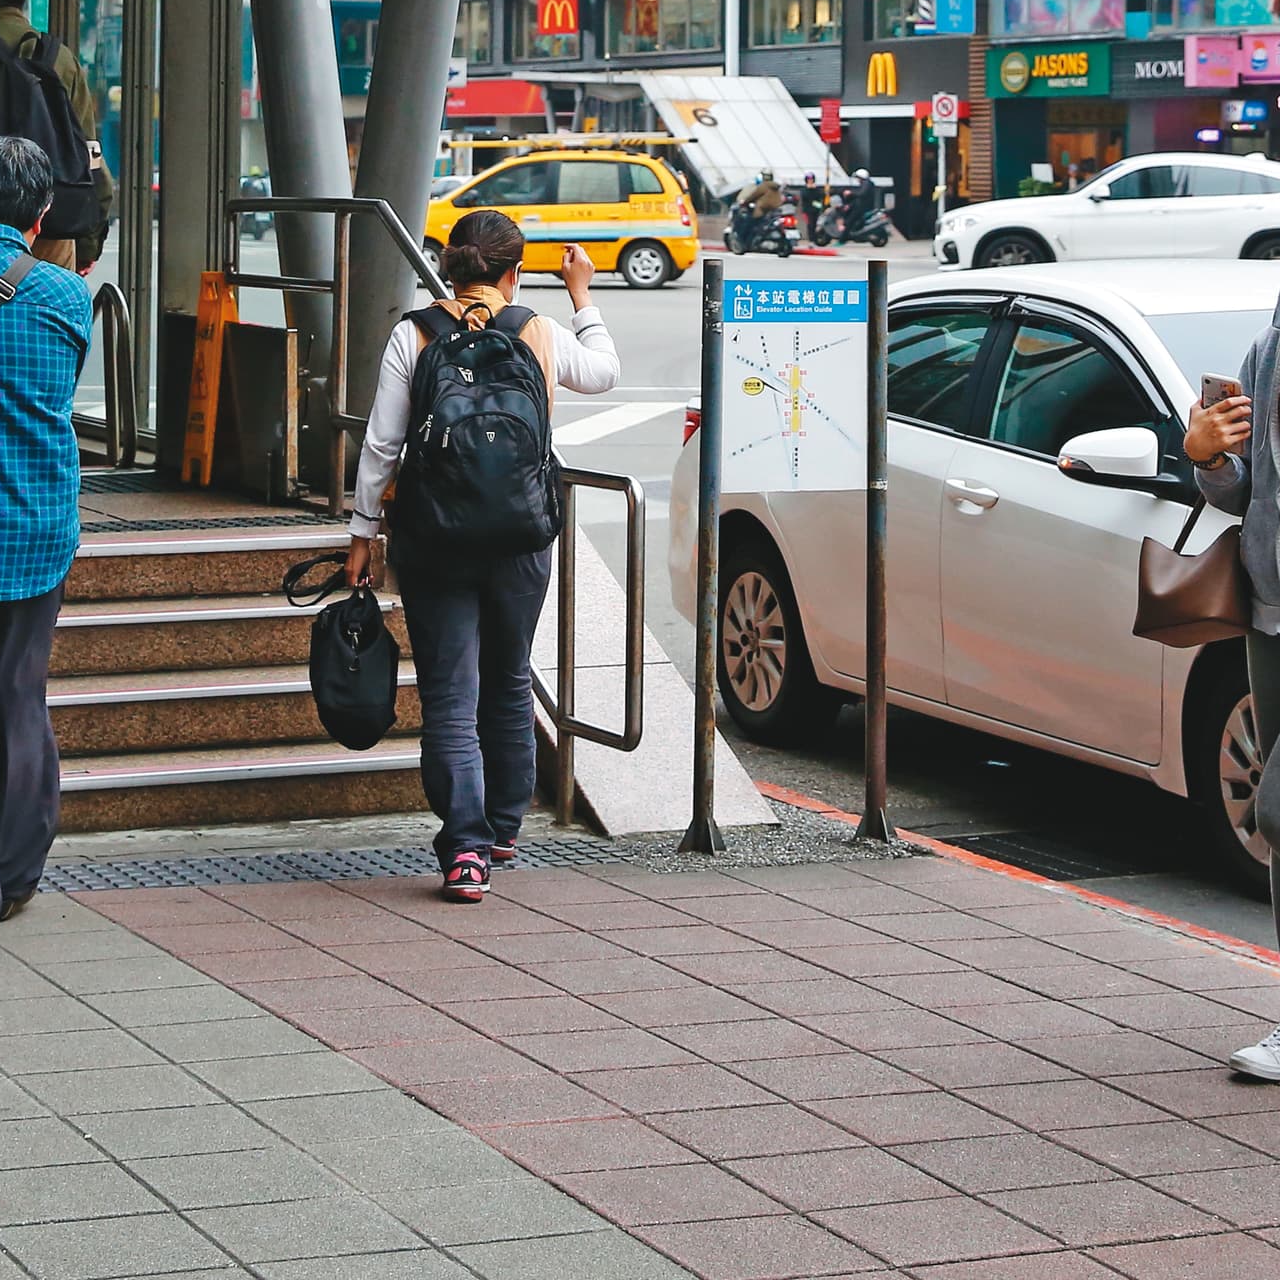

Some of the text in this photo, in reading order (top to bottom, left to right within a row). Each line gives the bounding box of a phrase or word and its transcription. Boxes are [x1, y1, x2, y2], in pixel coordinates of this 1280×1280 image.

[1031, 52, 1089, 78] JASONS
[692, 107, 718, 128] 6
[756, 289, 860, 305] 本站電梯位置圖
[756, 305, 833, 313] Elevator Location Guide
